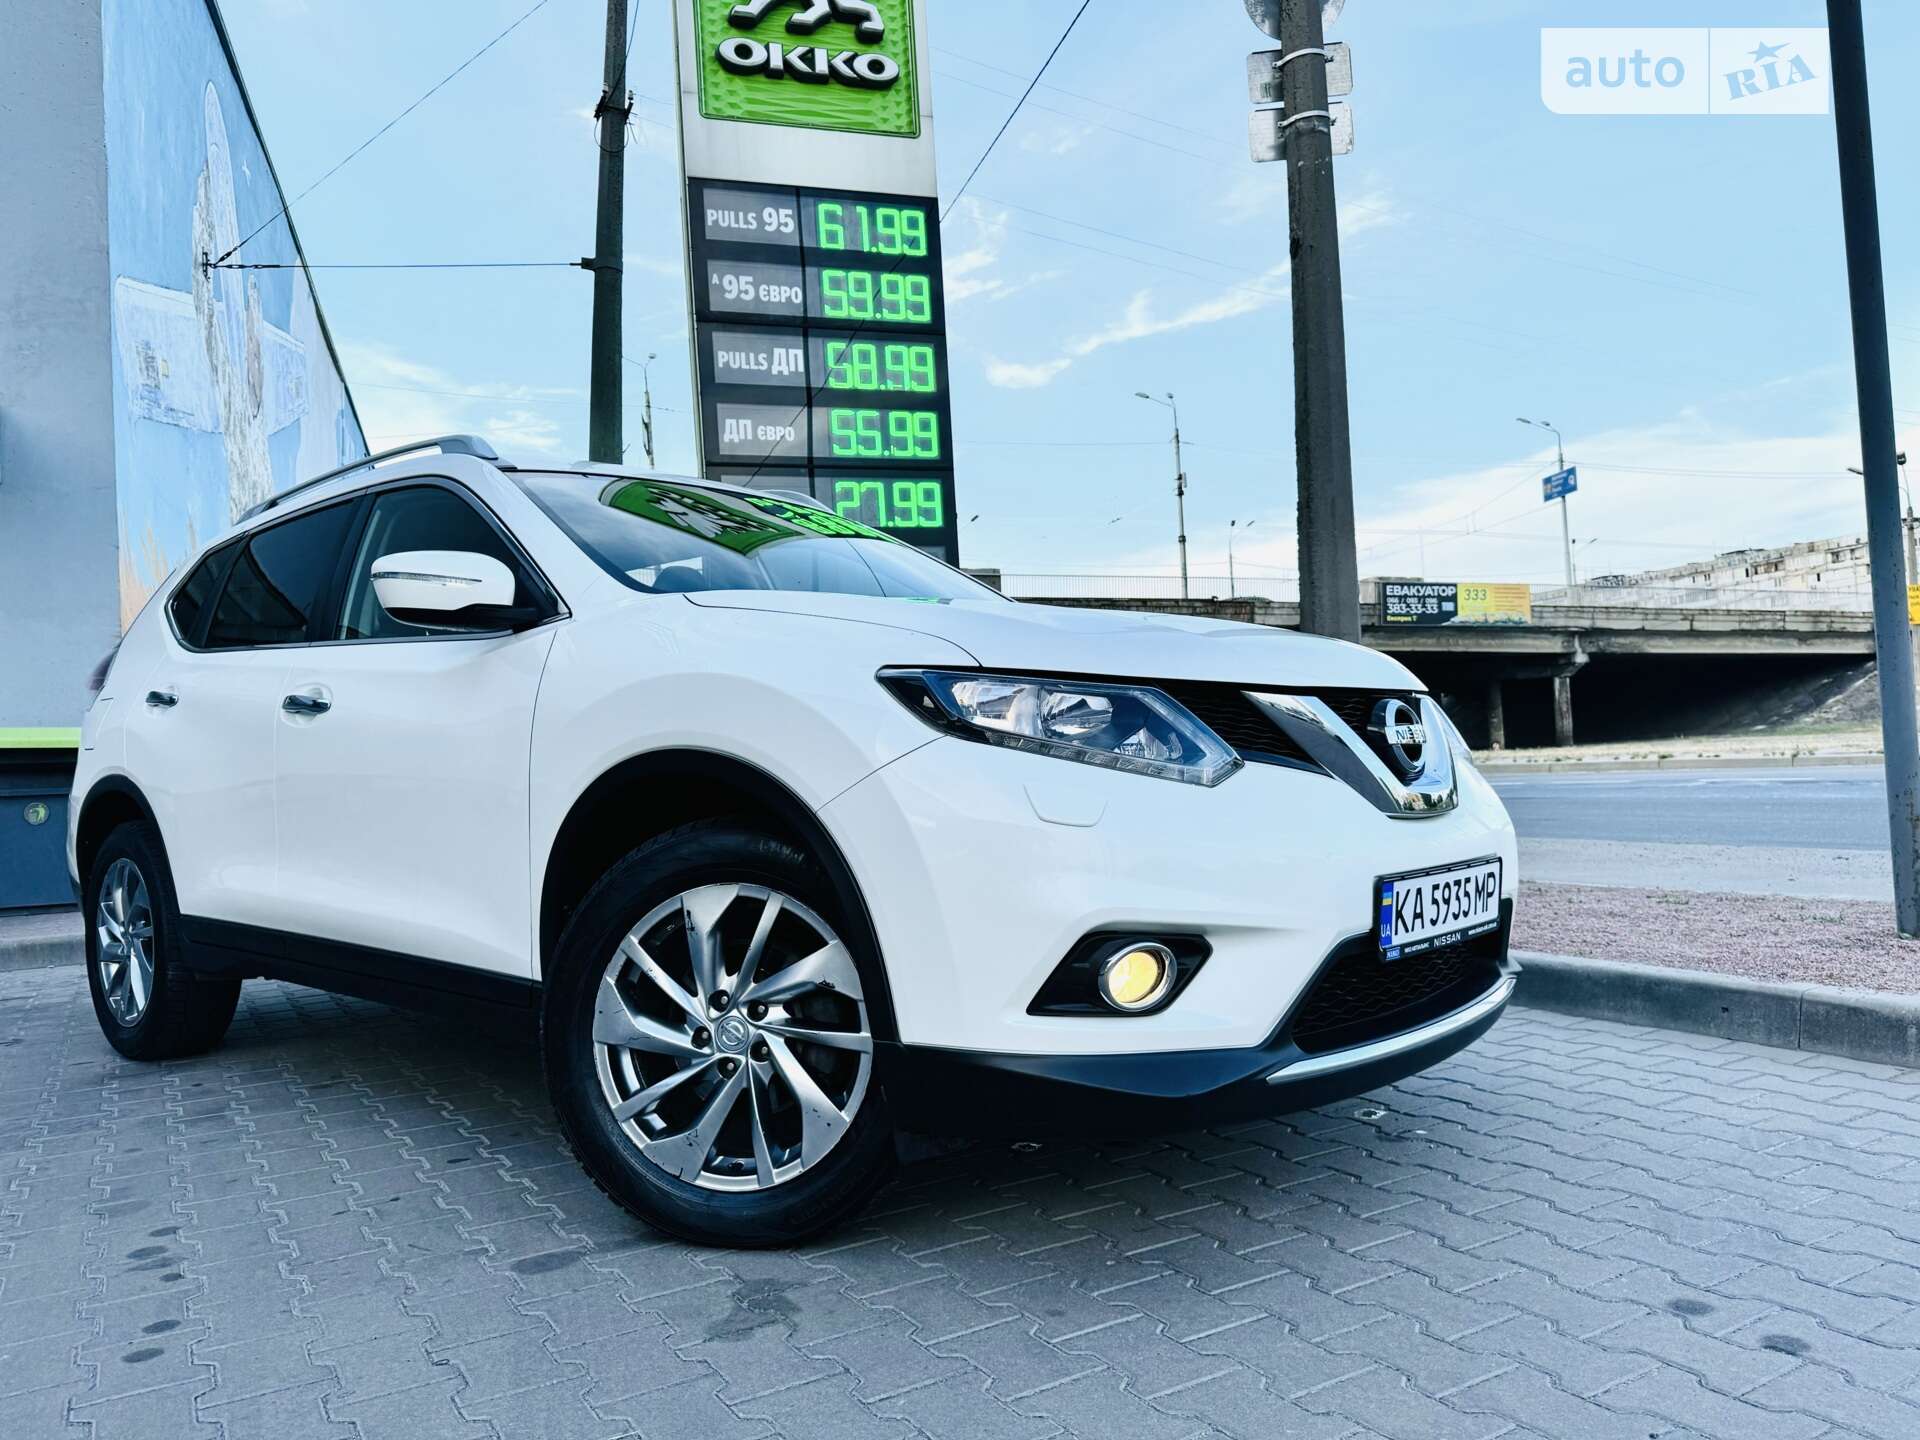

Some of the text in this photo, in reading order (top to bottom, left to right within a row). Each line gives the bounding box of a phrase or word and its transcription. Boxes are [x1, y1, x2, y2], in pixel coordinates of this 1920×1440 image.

[716, 37, 900, 86] OKKO
[706, 203, 928, 256] PULLS 95 61.99
[722, 273, 755, 301] 95
[822, 269, 932, 322] 59.99
[717, 342, 937, 393] PULLS ДП 58.99
[723, 418, 753, 443] ДП
[831, 409, 940, 458] 55.99
[835, 481, 943, 527] 27.99
[1386, 585, 1456, 597] ЕВАКУАТОР
[1386, 603, 1439, 614] 383-33-33
[1464, 588, 1488, 601] 333
[1394, 871, 1497, 936] KA 5935 MP
[1380, 923, 1391, 938] UA
[1433, 932, 1461, 948] NISSAN
